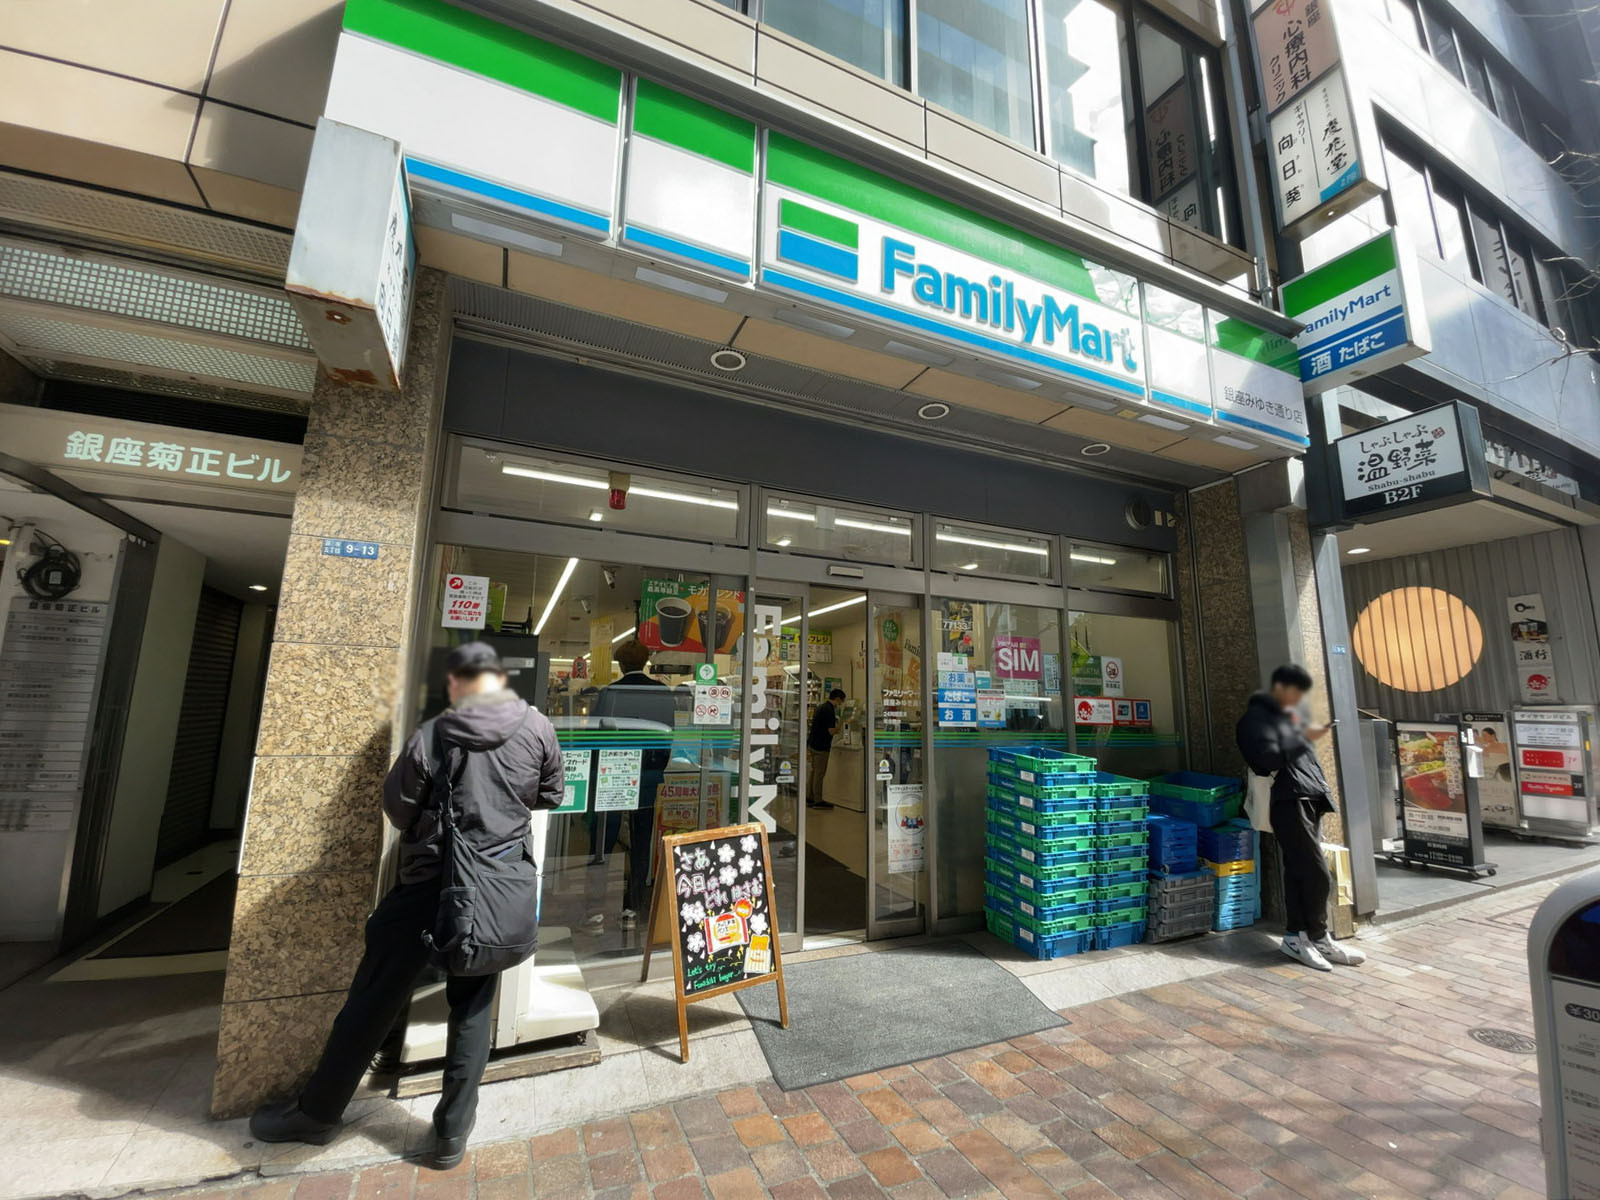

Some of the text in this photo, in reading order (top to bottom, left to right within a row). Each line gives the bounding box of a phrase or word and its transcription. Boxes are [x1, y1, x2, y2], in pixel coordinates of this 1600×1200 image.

[1268, 54, 1287, 104] クリニック
[1293, 103, 1306, 145] ギャラリー
[1278, 133, 1302, 208] 向日葵
[880, 235, 1138, 373] FamilyMart
[1296, 283, 1392, 337] amilyMart
[1311, 331, 1386, 377] 酒 たばこ
[1223, 385, 1304, 425] 銀座みゆき通り店
[64, 430, 292, 484] 銀座菊正ビル
[1360, 424, 1429, 454] しゃぶしゃぶ
[1357, 438, 1438, 484] 温野菜
[1383, 484, 1424, 505] B2F
[345, 544, 375, 556] 9-13
[998, 647, 1040, 673] SIM
[943, 690, 971, 702] たばこ
[687, 961, 717, 978] Let's try
